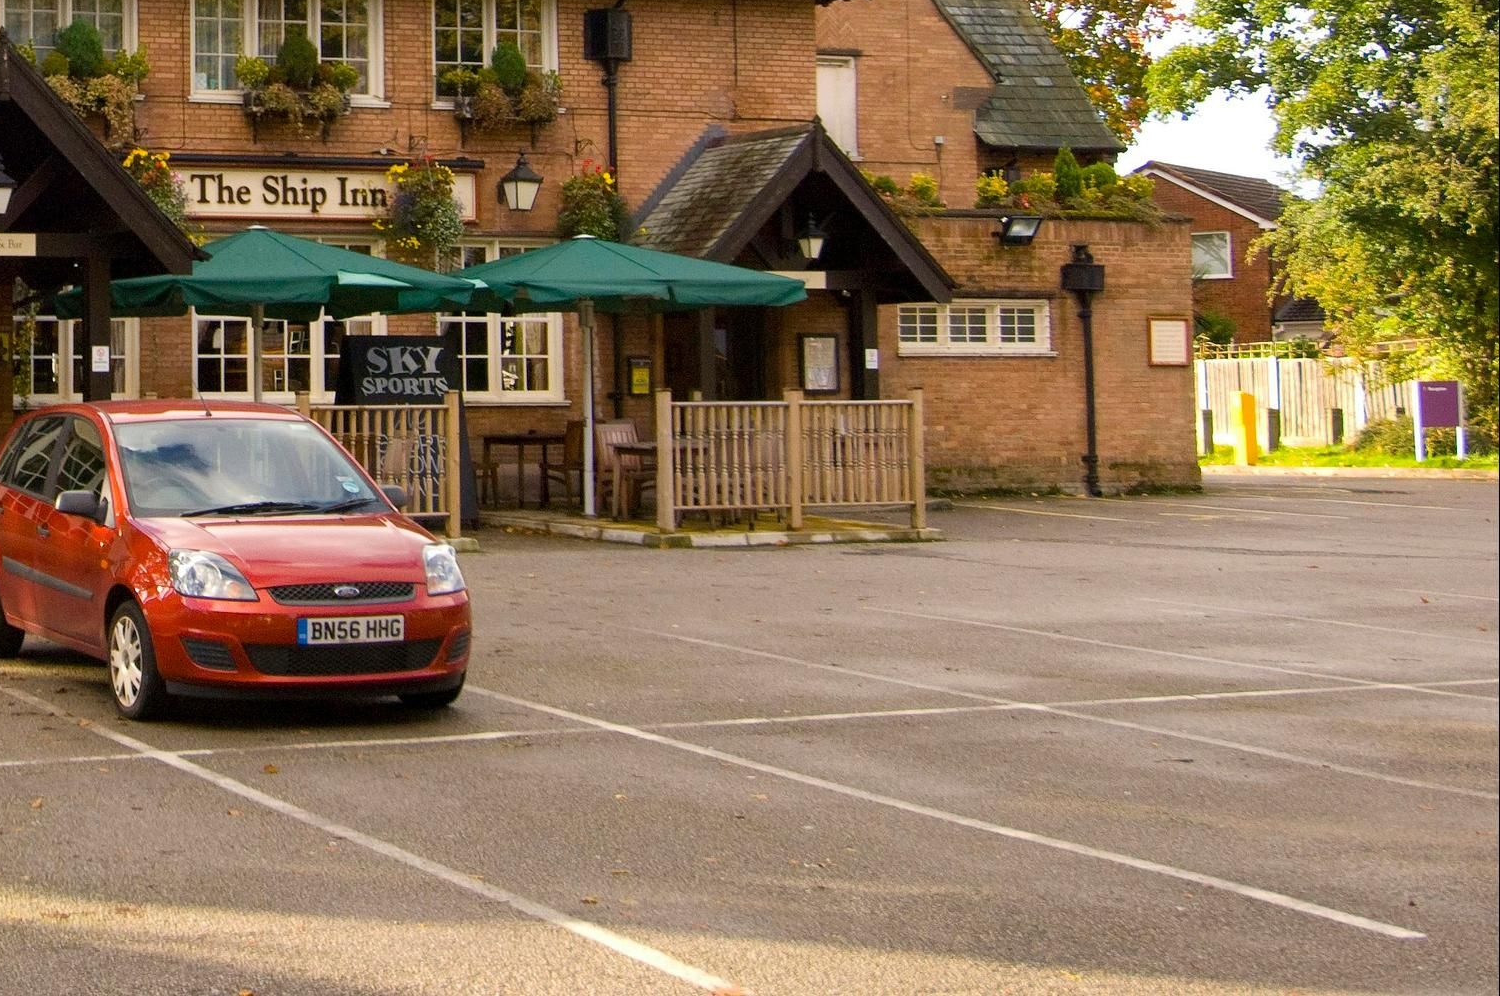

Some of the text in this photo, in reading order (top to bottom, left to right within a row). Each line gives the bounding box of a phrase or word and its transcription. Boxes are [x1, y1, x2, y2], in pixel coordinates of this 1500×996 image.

[190, 173, 389, 213] The Ship Inn
[8, 238, 23, 249] Bar
[366, 346, 445, 376] SKY
[361, 376, 449, 397] SPORTS
[311, 618, 401, 640] BN56 HHG
